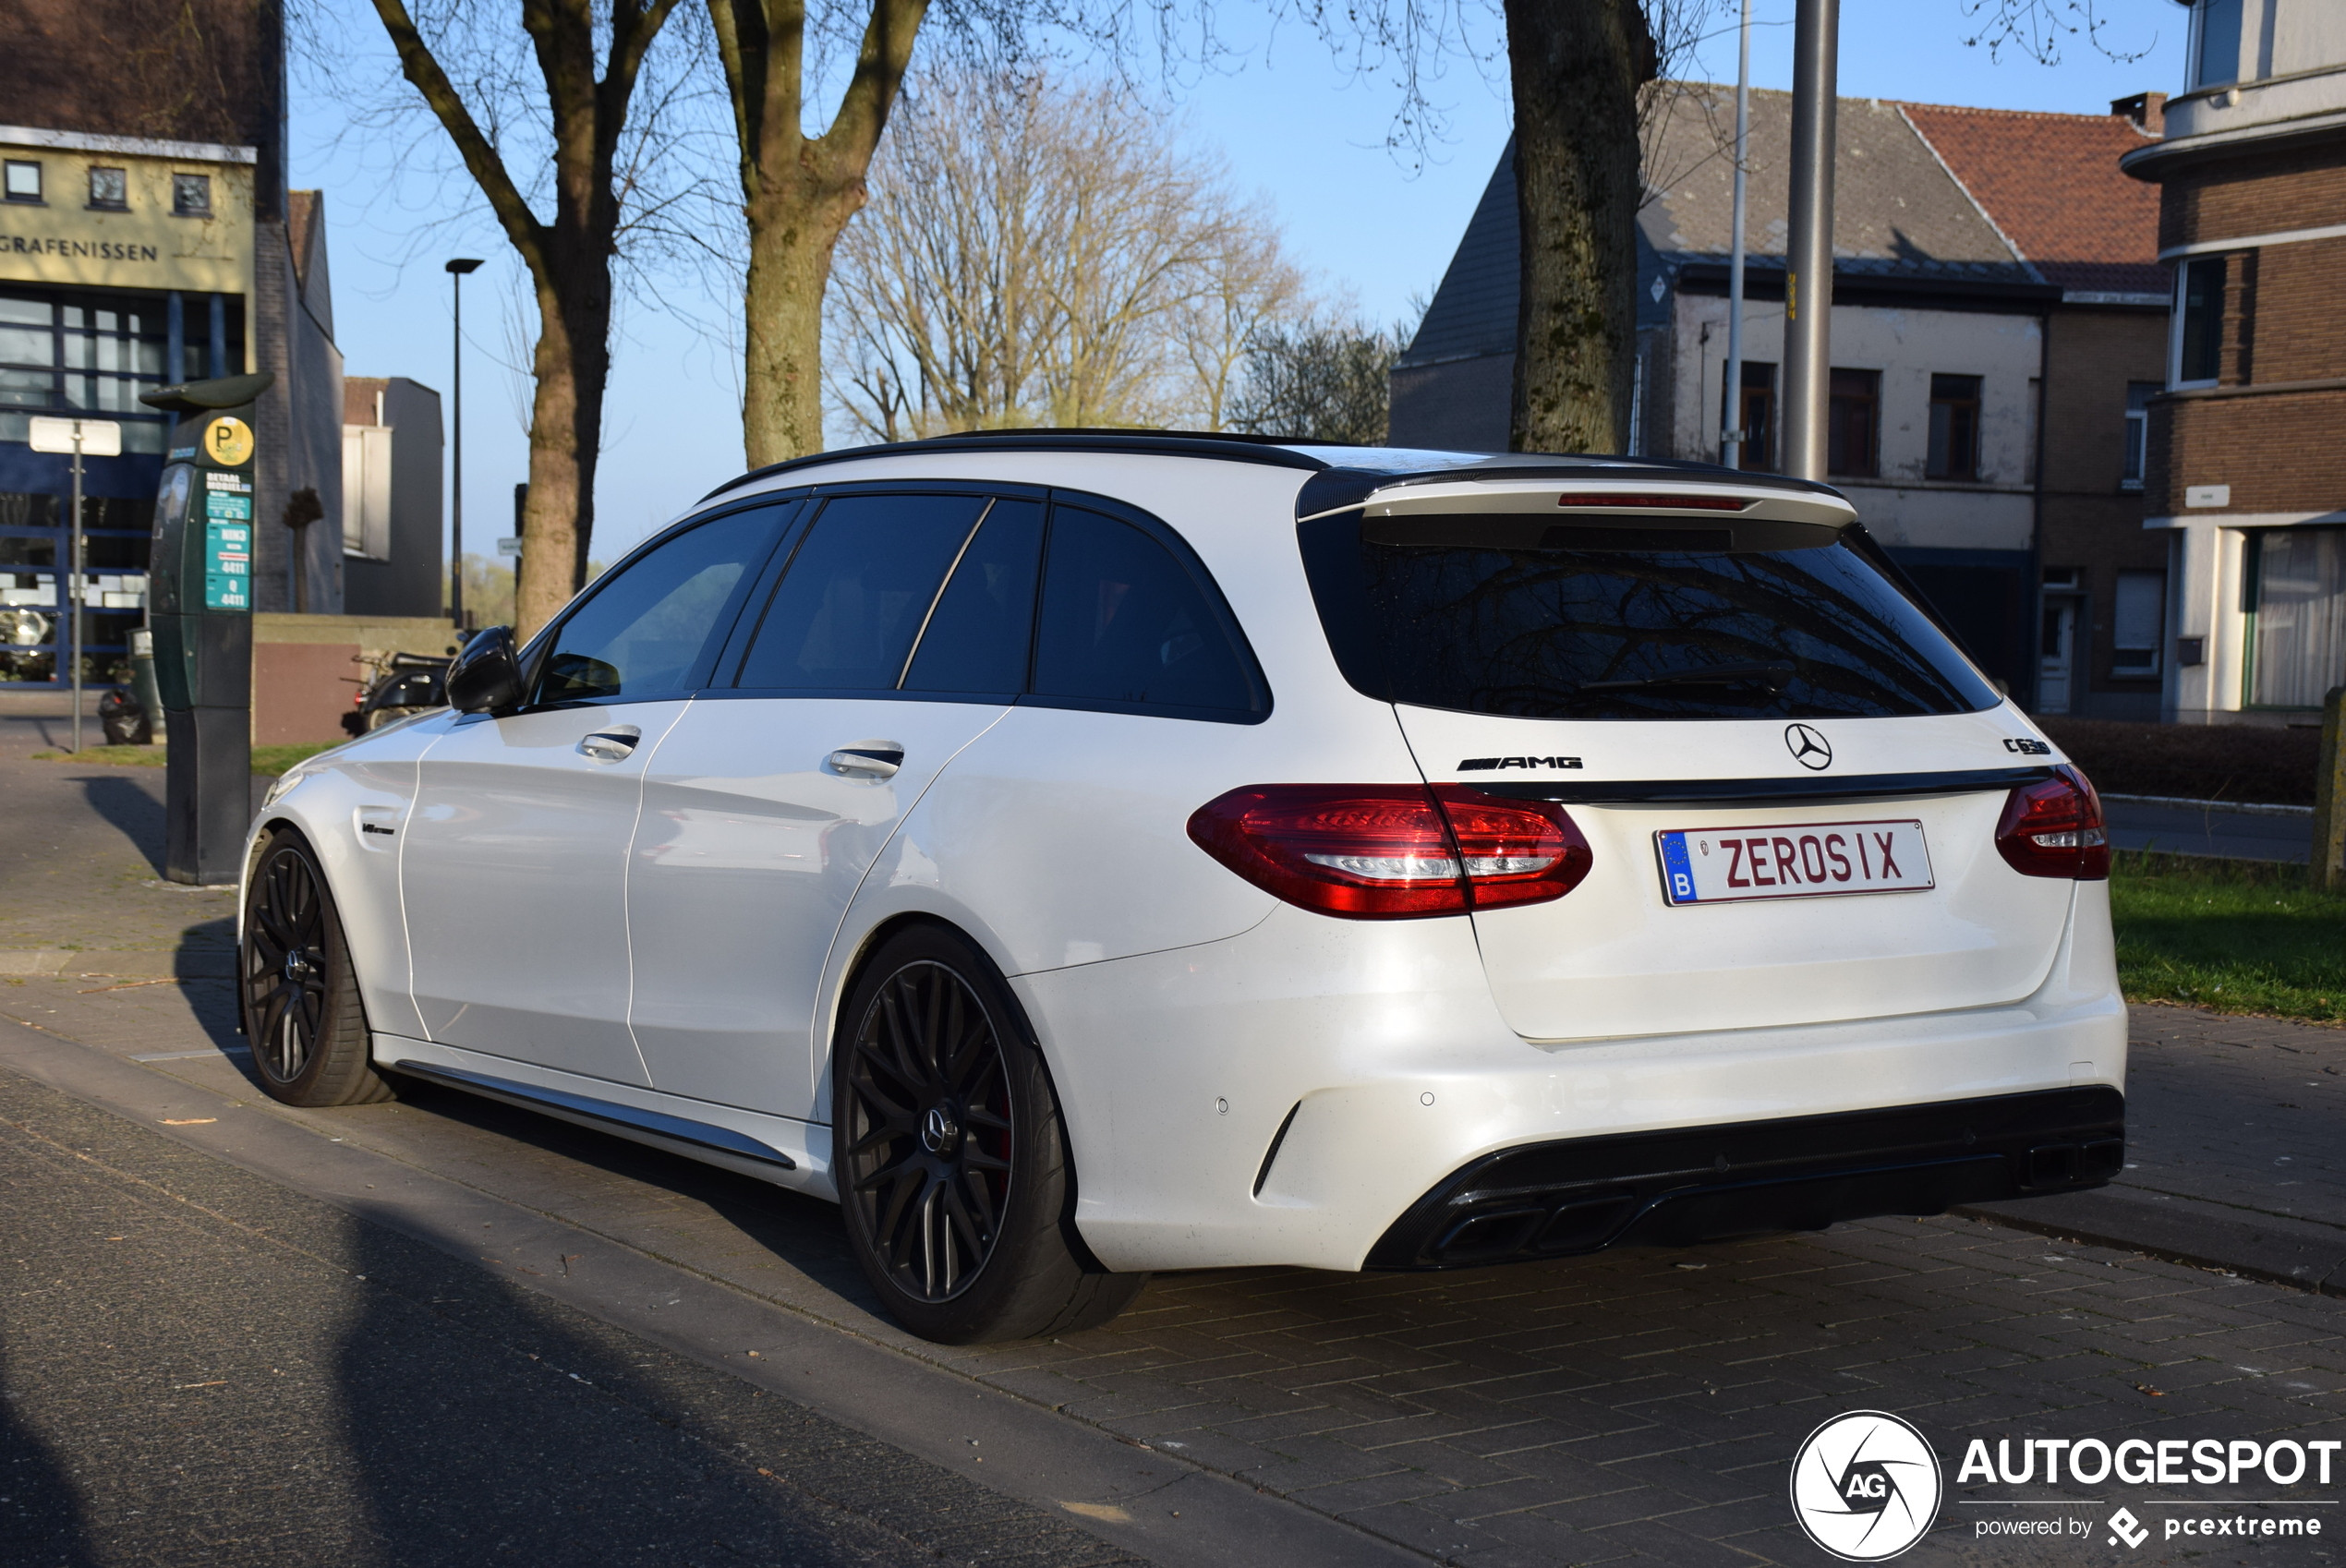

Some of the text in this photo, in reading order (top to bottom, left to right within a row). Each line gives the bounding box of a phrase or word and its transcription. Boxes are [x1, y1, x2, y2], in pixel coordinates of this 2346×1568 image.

[0, 235, 157, 262] GRAFENISSEN
[216, 426, 232, 452] P
[222, 561, 245, 574] 4411
[221, 593, 245, 606] 4411
[1497, 756, 1583, 769] AMG
[1719, 832, 1903, 888] ZEROSIX
[1674, 873, 1691, 897] B
